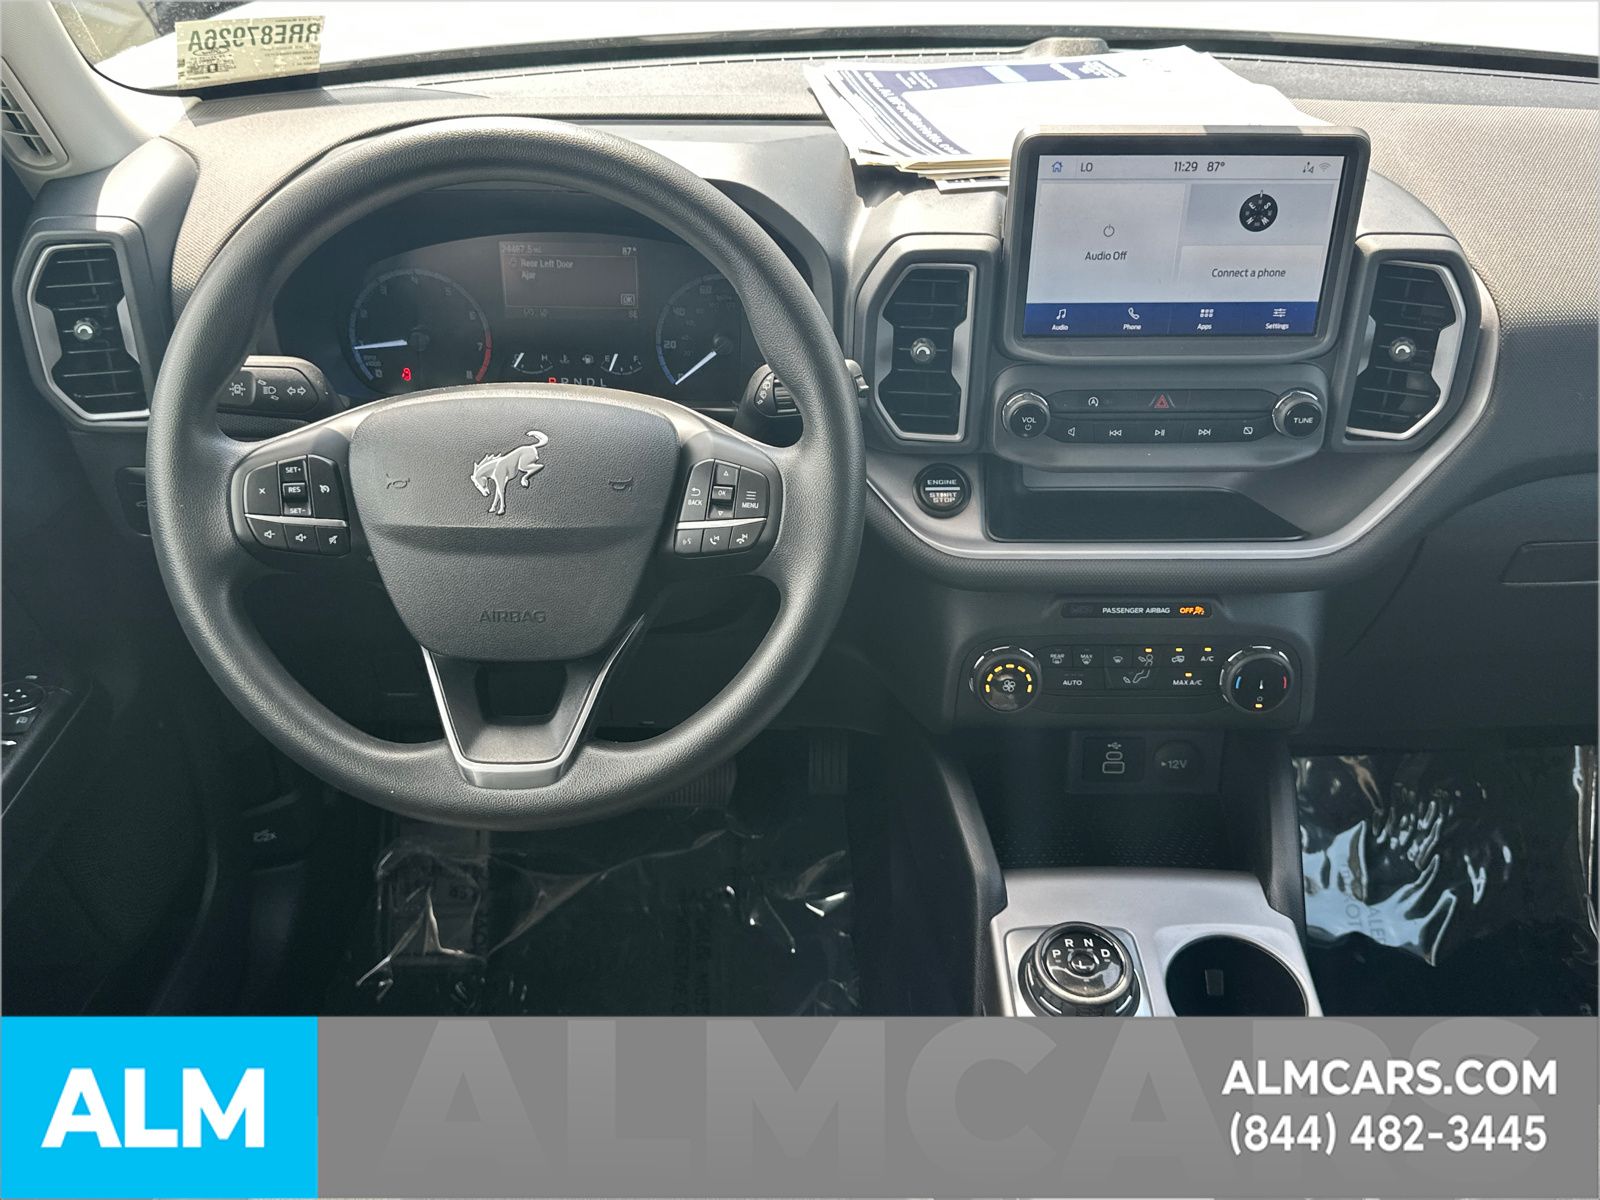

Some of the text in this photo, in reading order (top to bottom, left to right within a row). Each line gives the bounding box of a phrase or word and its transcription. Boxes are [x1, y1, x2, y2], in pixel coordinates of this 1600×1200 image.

[1080, 162, 1093, 172] LO
[1173, 161, 1225, 172] 11:29 87°
[1085, 251, 1128, 261] Audio Off
[520, 259, 574, 269] Rear Left Door
[521, 271, 537, 280] Ajar
[1211, 268, 1286, 280] Connect a phone
[1052, 323, 1069, 331] Audio
[1123, 323, 1142, 331] Phone
[1197, 323, 1212, 332] Apps
[1265, 322, 1290, 332] Settings
[663, 340, 677, 349] 20
[1021, 416, 1037, 424] VOL
[1293, 416, 1313, 424] TUNE
[1179, 607, 1194, 615] OFF
[480, 610, 546, 624] AIRBAG
[1167, 760, 1187, 769] 12V
[1064, 938, 1094, 947] R N
[1052, 949, 1062, 958] P
[1100, 949, 1110, 958] D
